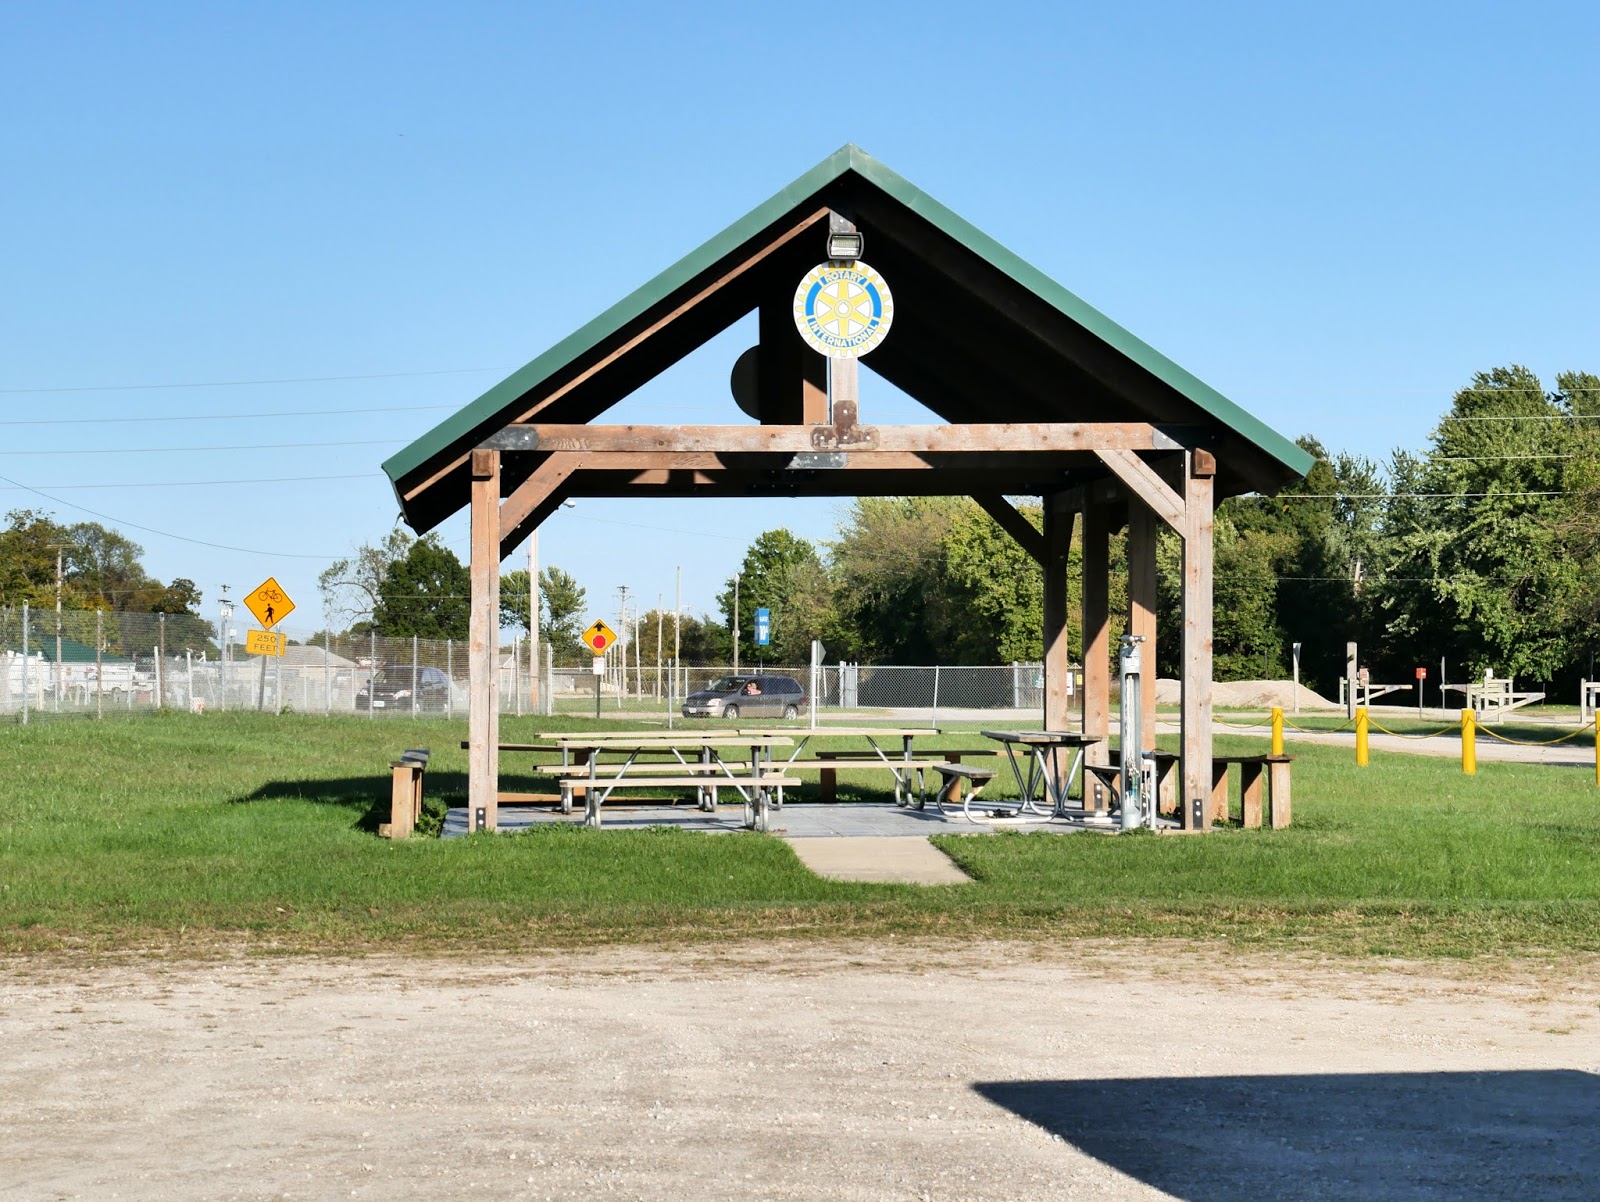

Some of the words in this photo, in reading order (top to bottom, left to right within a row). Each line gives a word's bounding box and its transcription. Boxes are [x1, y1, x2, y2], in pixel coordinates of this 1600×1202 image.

[825, 271, 864, 283] ROTARY
[810, 322, 878, 347] INTERNATIONAL
[256, 634, 277, 643] 250
[253, 643, 278, 652] FEET
